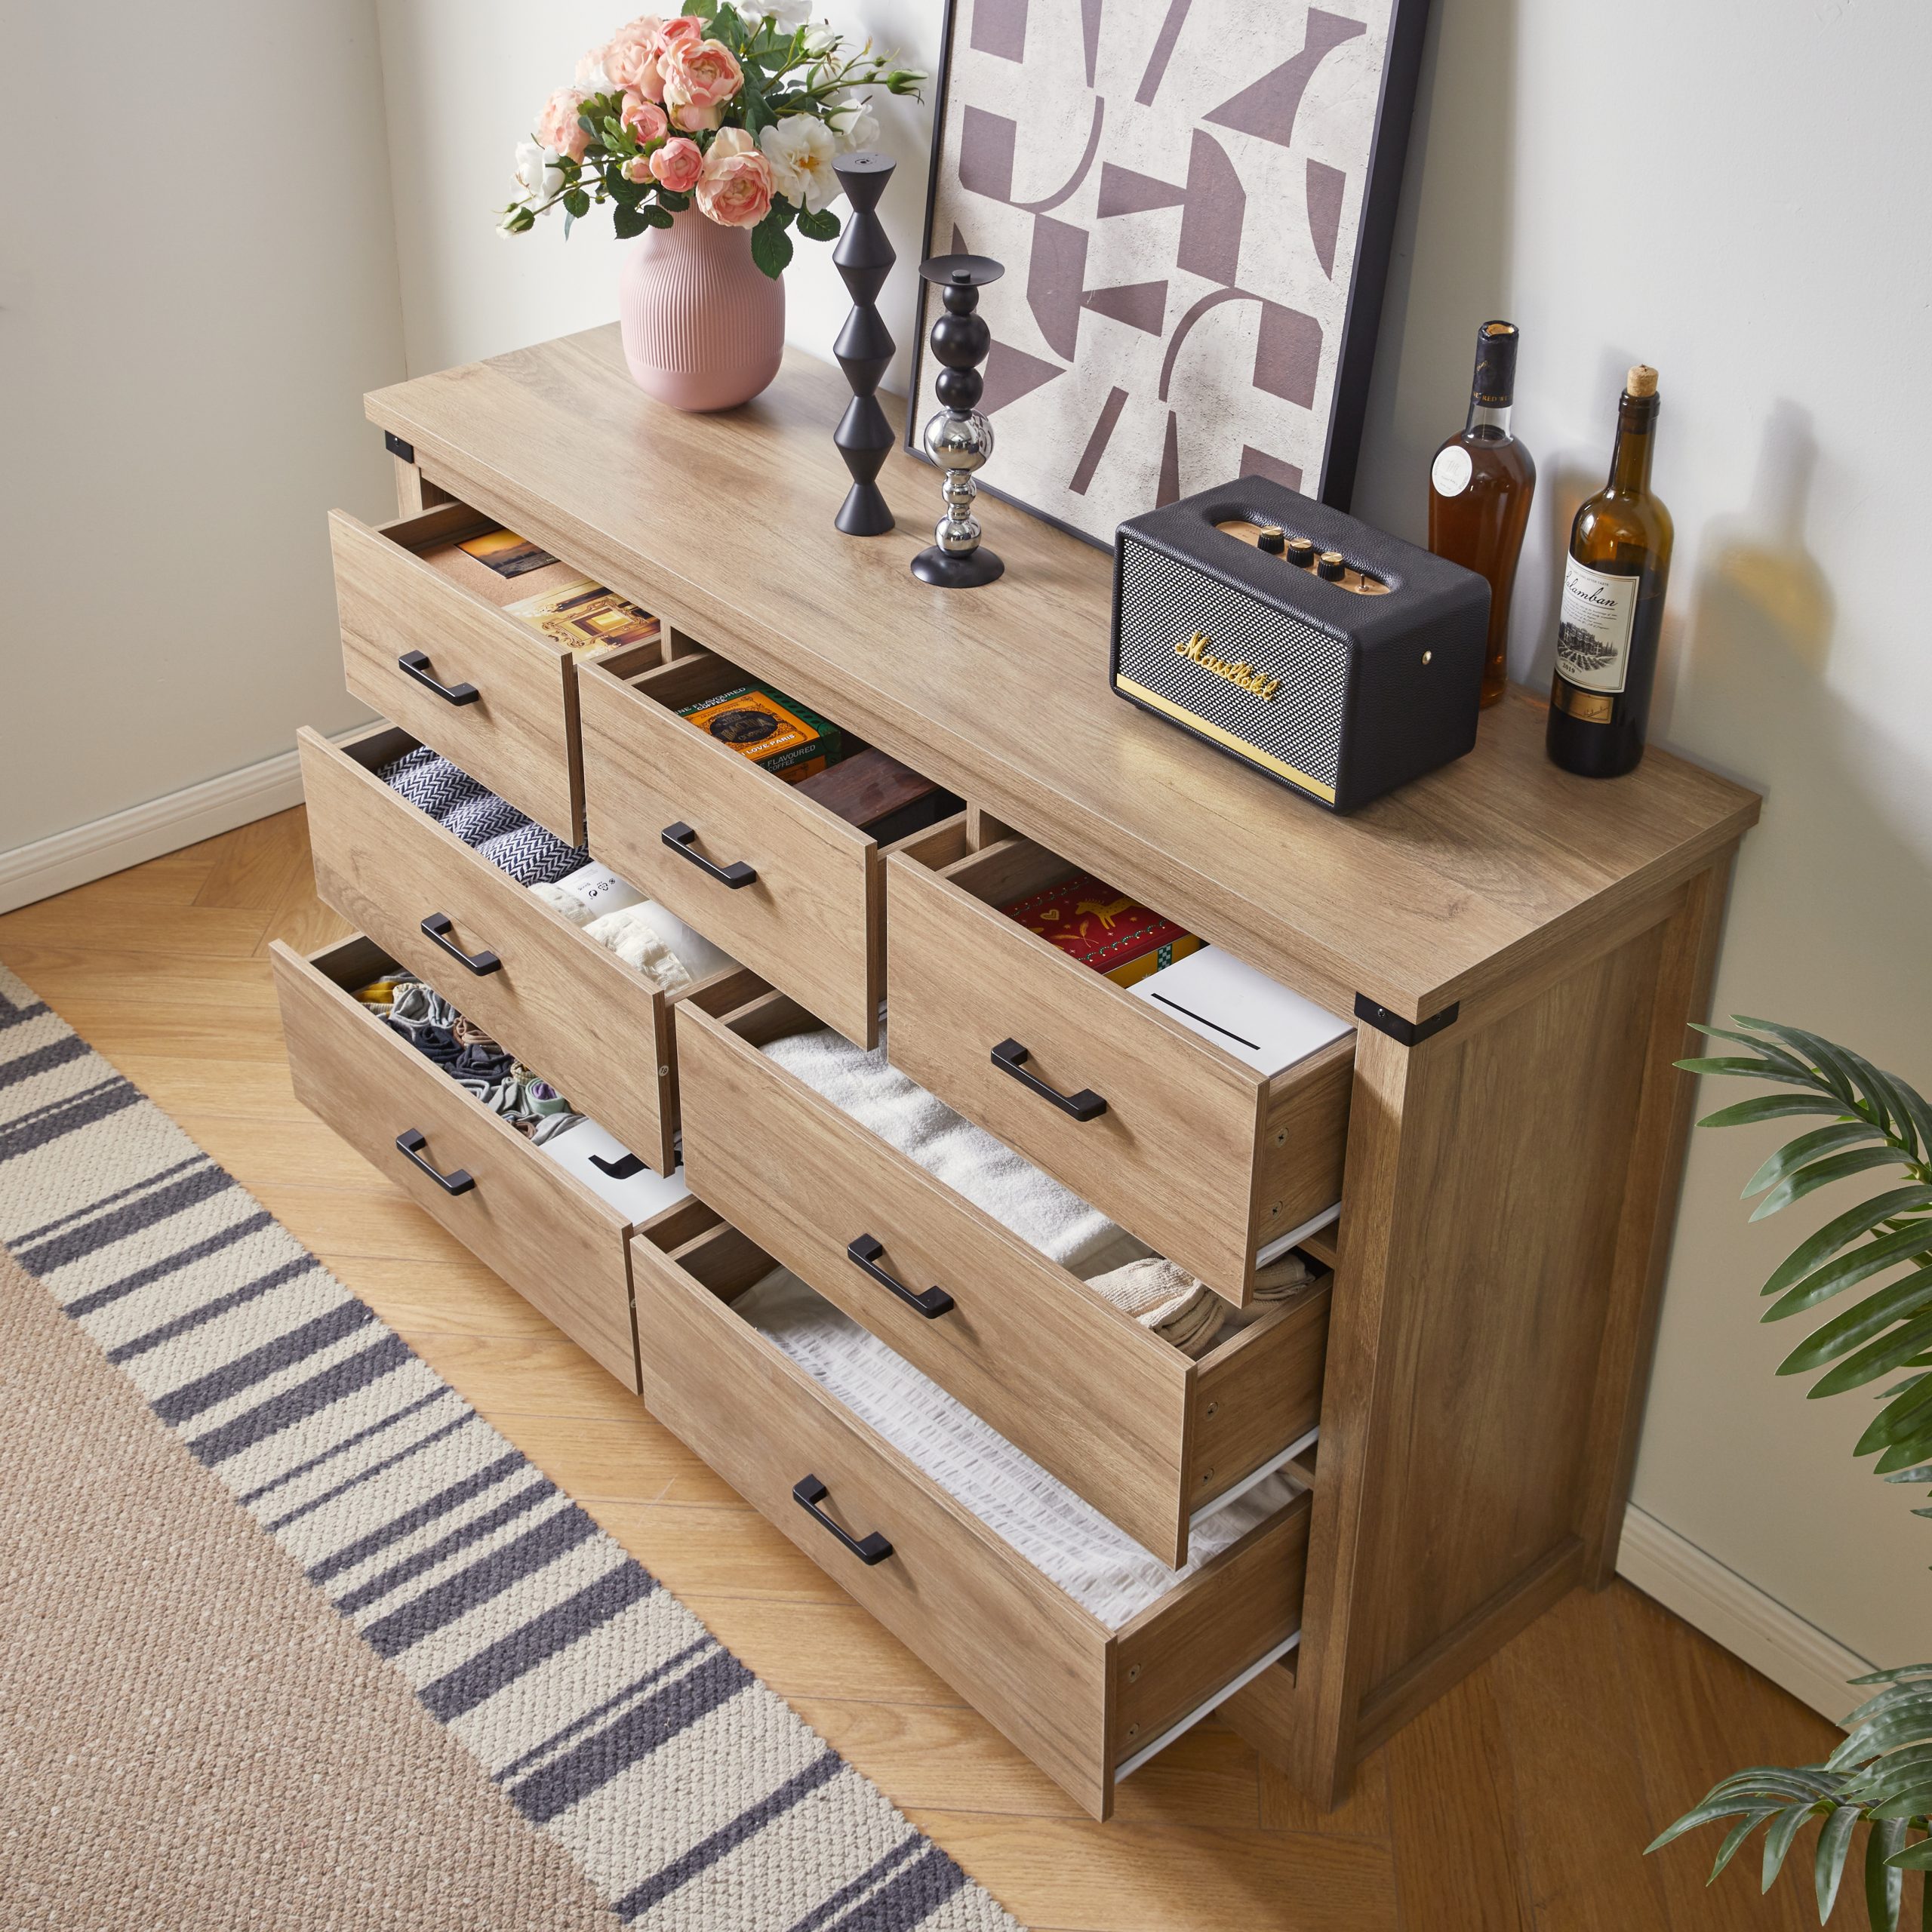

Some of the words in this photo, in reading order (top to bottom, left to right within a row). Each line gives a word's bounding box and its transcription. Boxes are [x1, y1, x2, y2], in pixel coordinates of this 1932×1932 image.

[1562, 663, 1575, 673] 2019
[675, 706, 692, 715] INE
[697, 698, 728, 711] COFFEE
[746, 743, 770, 754] LOVE
[770, 734, 796, 746] PARIS
[767, 744, 816, 767] FLAVOURED
[768, 758, 795, 772] COFFEE
